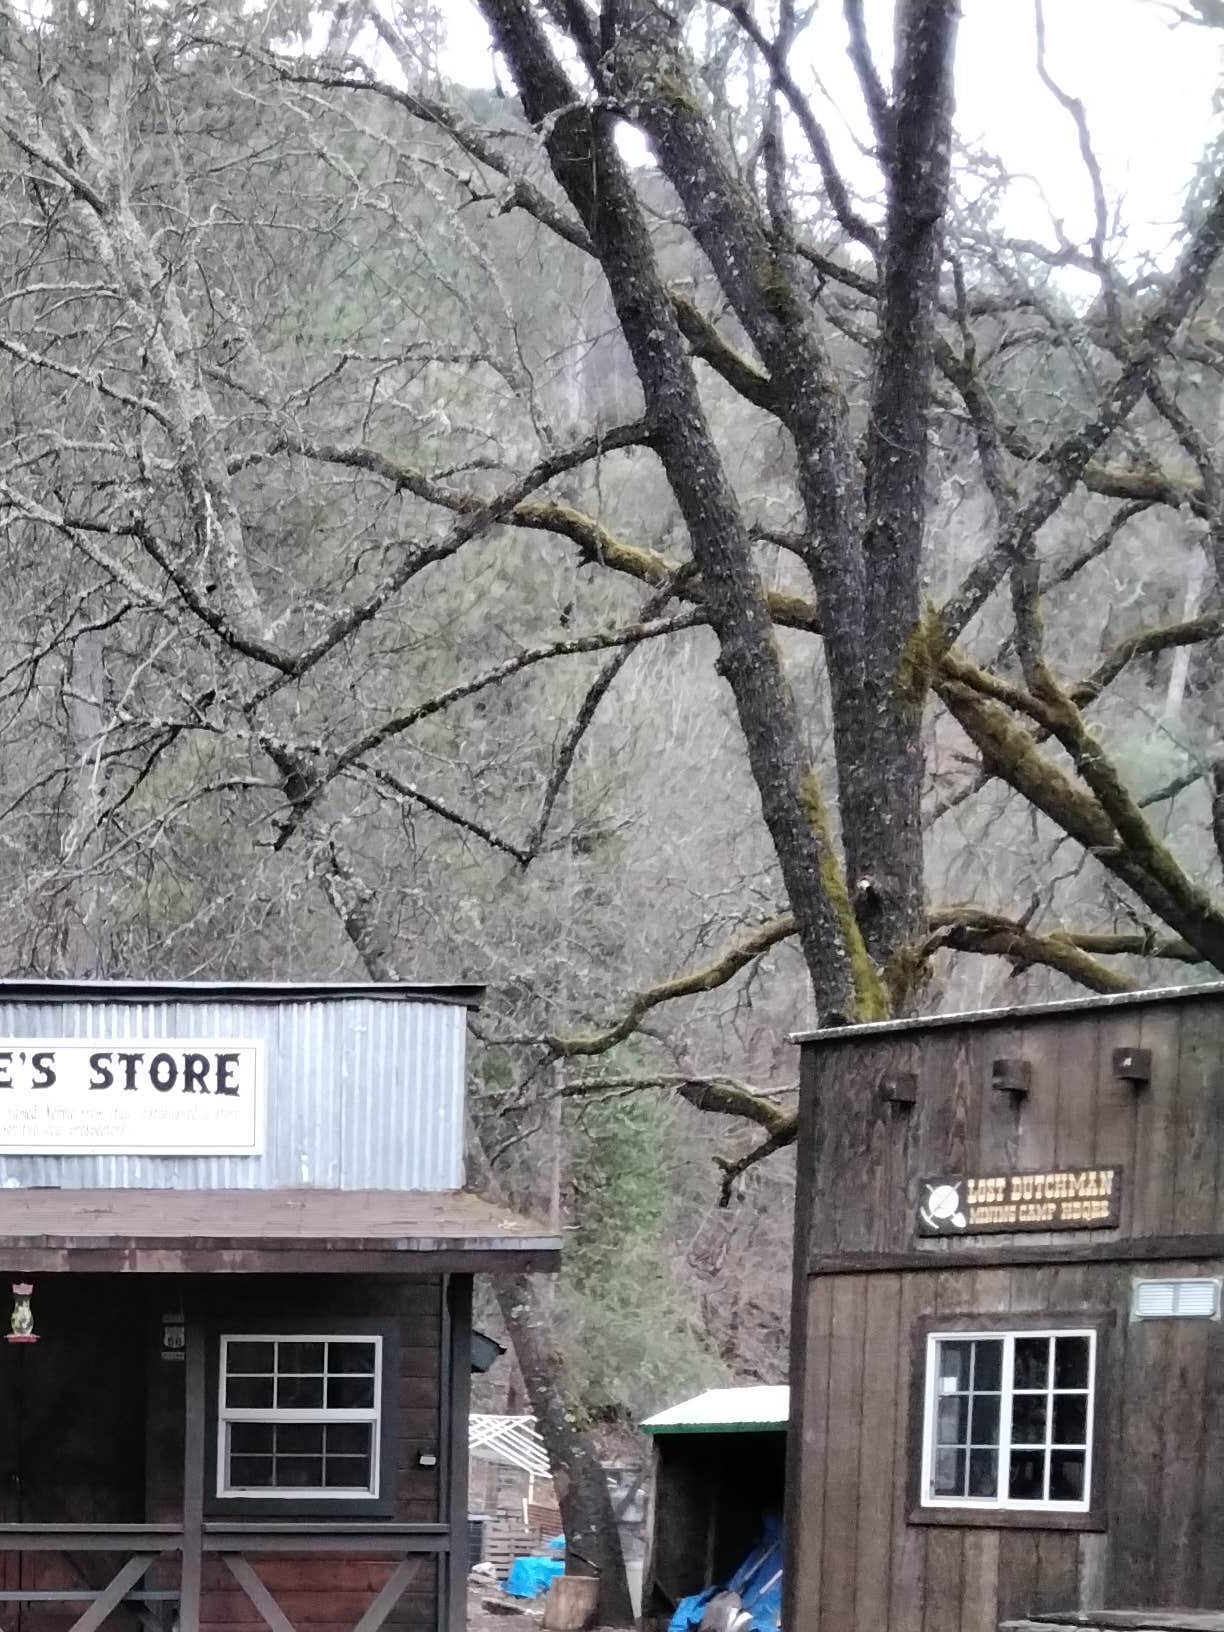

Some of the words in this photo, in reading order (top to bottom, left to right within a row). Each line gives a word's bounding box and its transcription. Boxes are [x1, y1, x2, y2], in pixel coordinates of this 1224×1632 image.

[88, 1052, 242, 1097] STORE
[967, 1177, 1006, 1204] LOST
[1010, 1170, 1115, 1200] DUTCHMAN
[1019, 1202, 1057, 1222] CAMP
